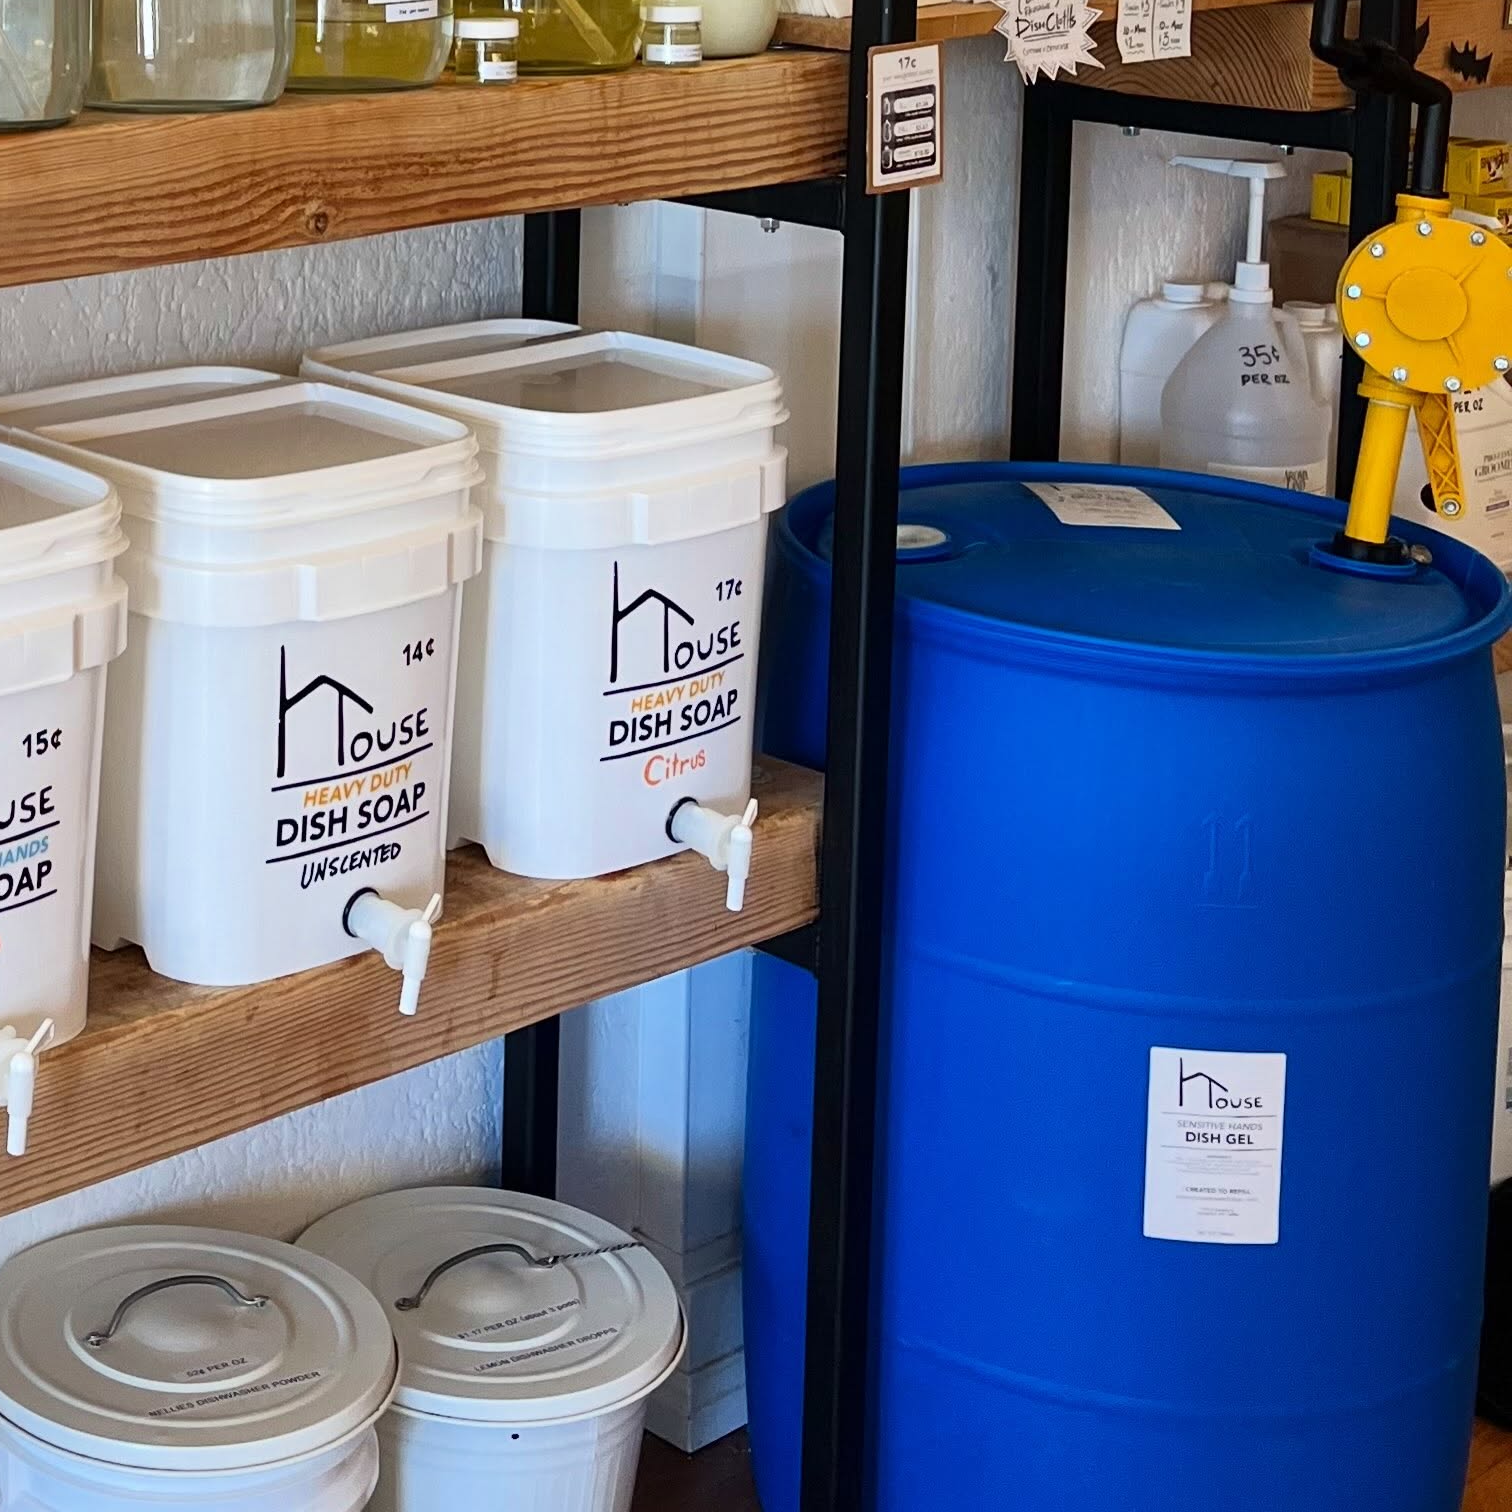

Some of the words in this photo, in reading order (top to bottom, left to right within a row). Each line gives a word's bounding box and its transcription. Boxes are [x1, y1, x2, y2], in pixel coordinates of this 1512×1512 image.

[1239, 345, 1280, 367] 35¢
[1241, 374, 1272, 386] PER
[1274, 374, 1291, 384] OZ
[1454, 400, 1471, 413] PER
[1472, 398, 1484, 411] OZ
[402, 637, 435, 666] 14¢
[631, 684, 687, 714] HEAVY
[688, 670, 727, 698] DUTY
[609, 709, 672, 747] DISH
[679, 688, 738, 731] SOAP
[22, 728, 63, 758] 15¢
[303, 777, 366, 808] HEAVY
[370, 761, 413, 793] DUTY
[643, 749, 706, 786] Citrus
[276, 806, 348, 847] DISH
[357, 781, 426, 829] SOAP
[300, 842, 402, 890] UNSCENTED
[1176, 1119, 1225, 1130] SENSITIVE
[1228, 1121, 1263, 1131] HANDS
[1185, 1131, 1221, 1144] DISH
[1226, 1133, 1254, 1145] GEL
[457, 1328, 482, 1339] $1.17
[484, 1322, 505, 1332] PER
[505, 1317, 519, 1325] OZ
[520, 1309, 548, 1322] (about
[557, 1297, 581, 1311] pods)
[206, 1362, 229, 1371] PER
[231, 1357, 248, 1366] OZ
[474, 1359, 510, 1373] LEMON
[510, 1340, 576, 1362] DISHWASHER
[576, 1327, 618, 1344] DROPPS
[148, 1402, 195, 1417] NELLIES
[196, 1383, 271, 1406] DISHWASHER
[273, 1371, 321, 1388] POWDER
